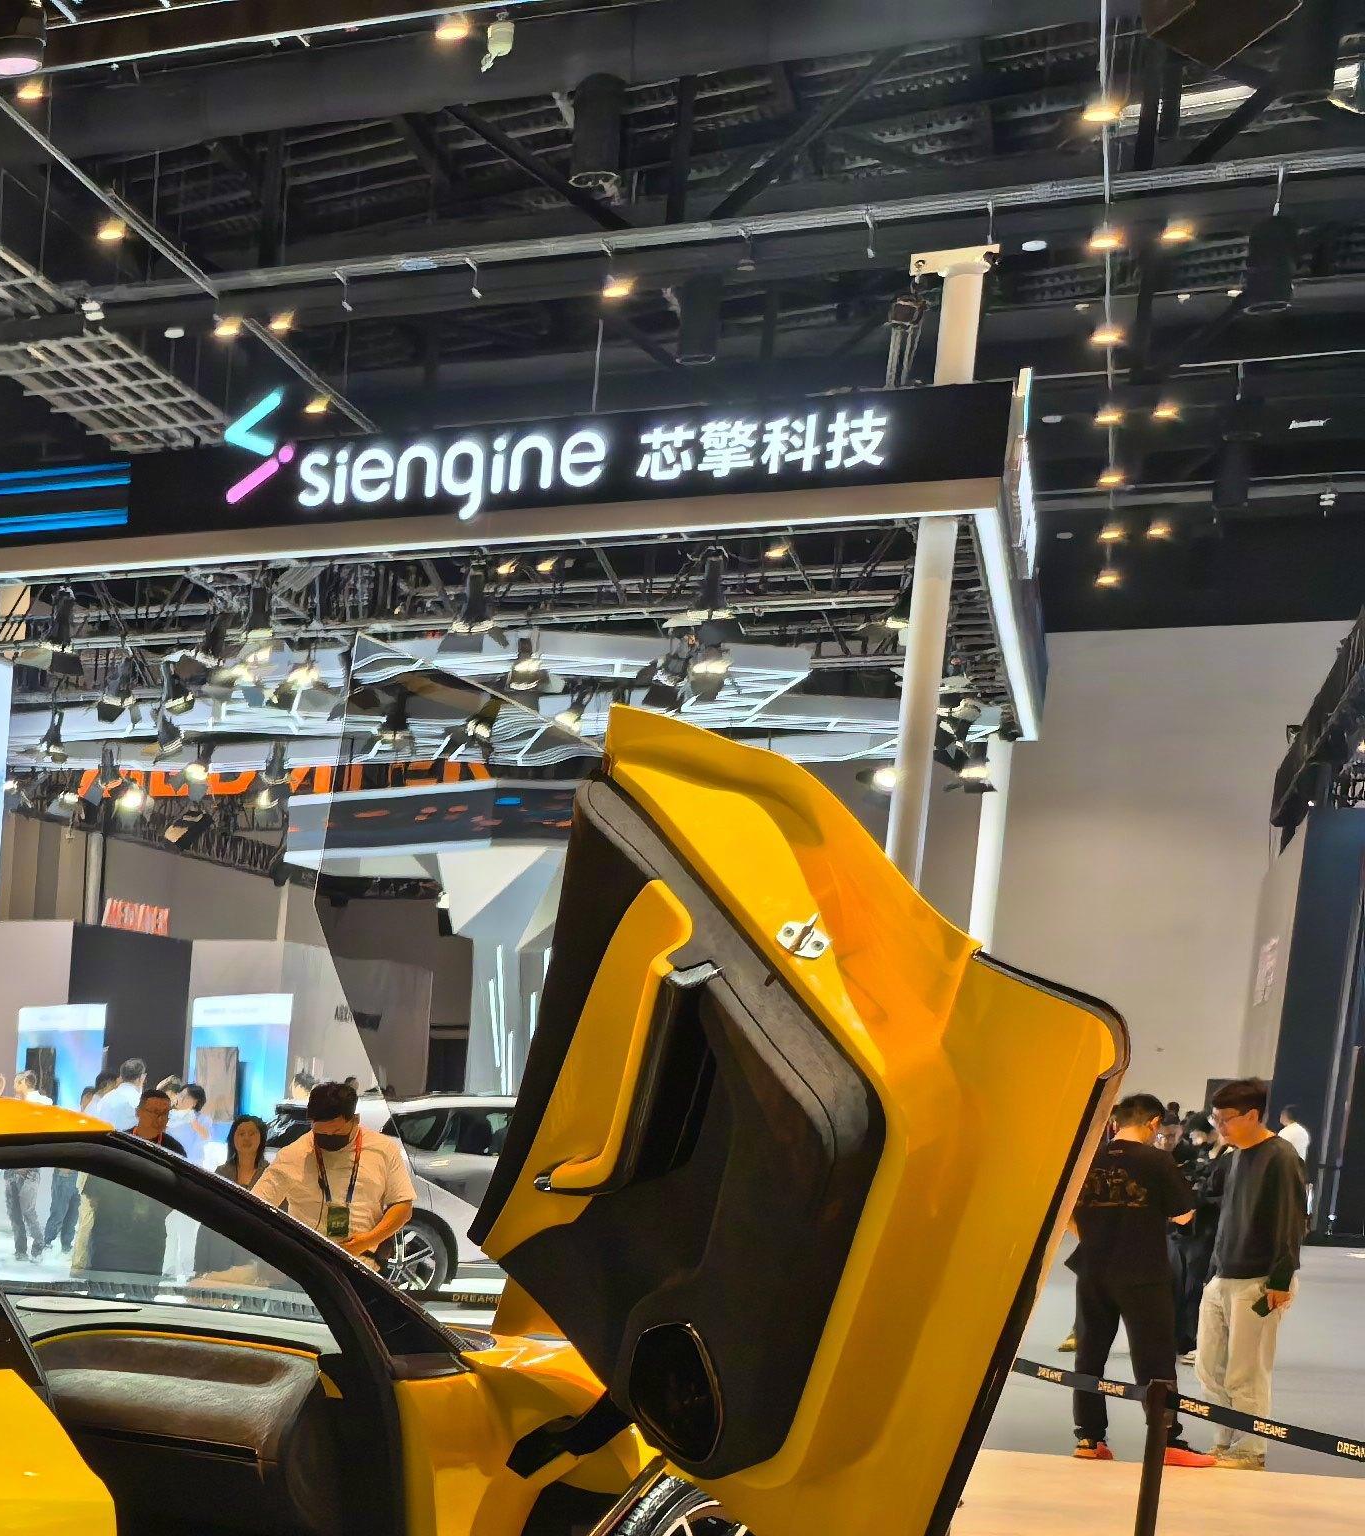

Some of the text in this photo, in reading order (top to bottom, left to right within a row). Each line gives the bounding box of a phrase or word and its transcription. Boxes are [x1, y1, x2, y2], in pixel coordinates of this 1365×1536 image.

[298, 428, 607, 520] siengine
[636, 408, 888, 480] 芯擎科技
[1253, 1420, 1288, 1438] DREAME
